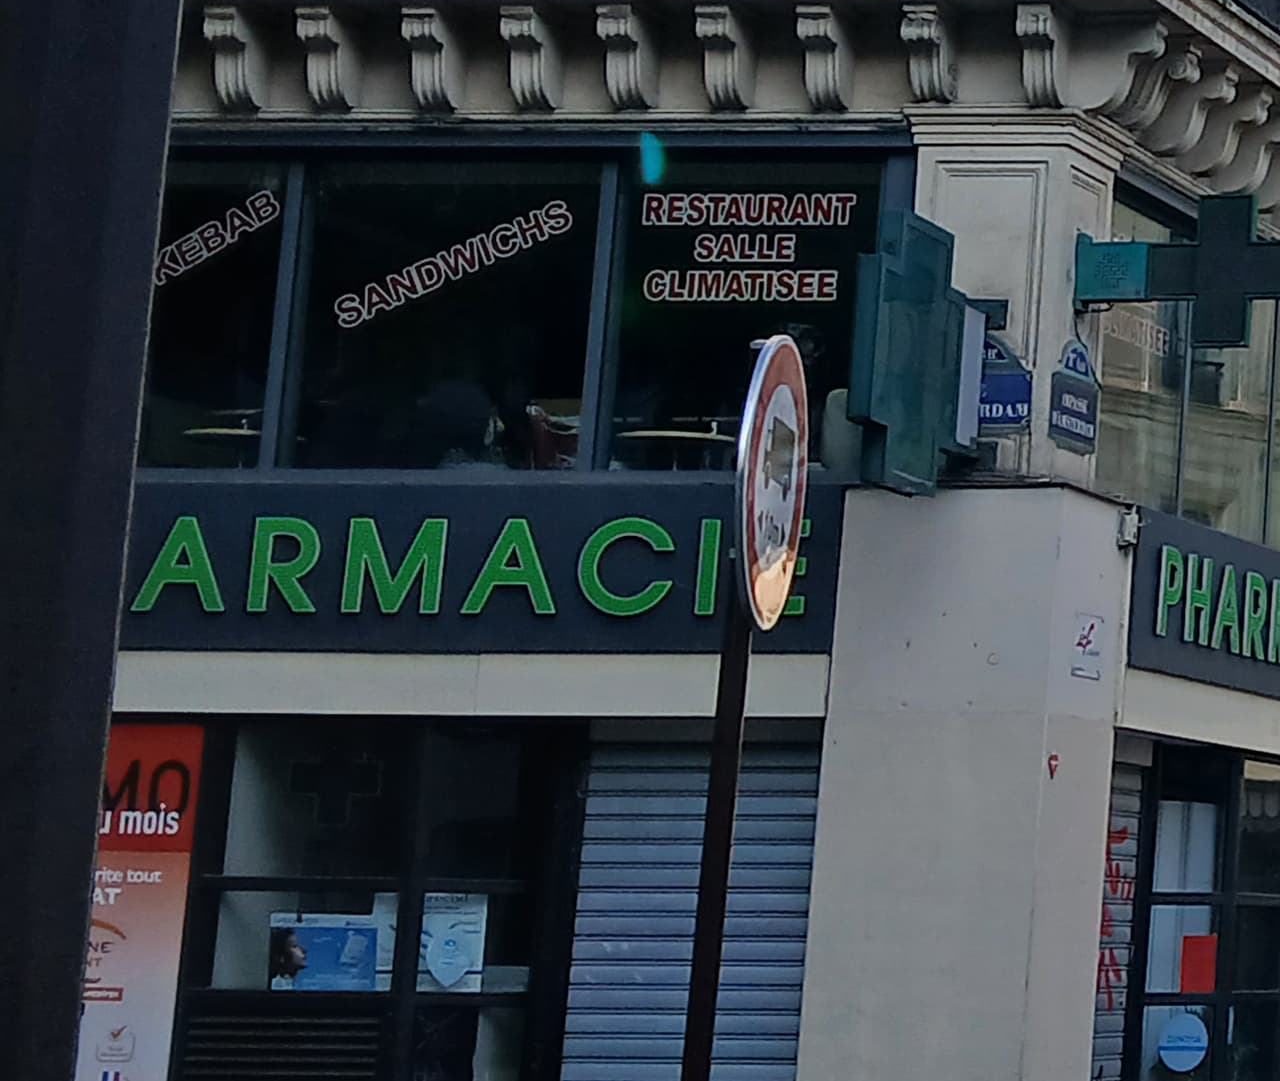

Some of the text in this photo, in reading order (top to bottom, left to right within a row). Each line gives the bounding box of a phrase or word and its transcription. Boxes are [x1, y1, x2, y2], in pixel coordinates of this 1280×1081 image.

[642, 193, 857, 227] RESTAURANT
[153, 190, 281, 286] KEBAB
[694, 233, 796, 264] SALLE
[335, 199, 574, 329] SANDWICHS
[643, 269, 839, 303] CLIMATISEE
[130, 516, 811, 618] ARMACI
[118, 802, 180, 835] mois
